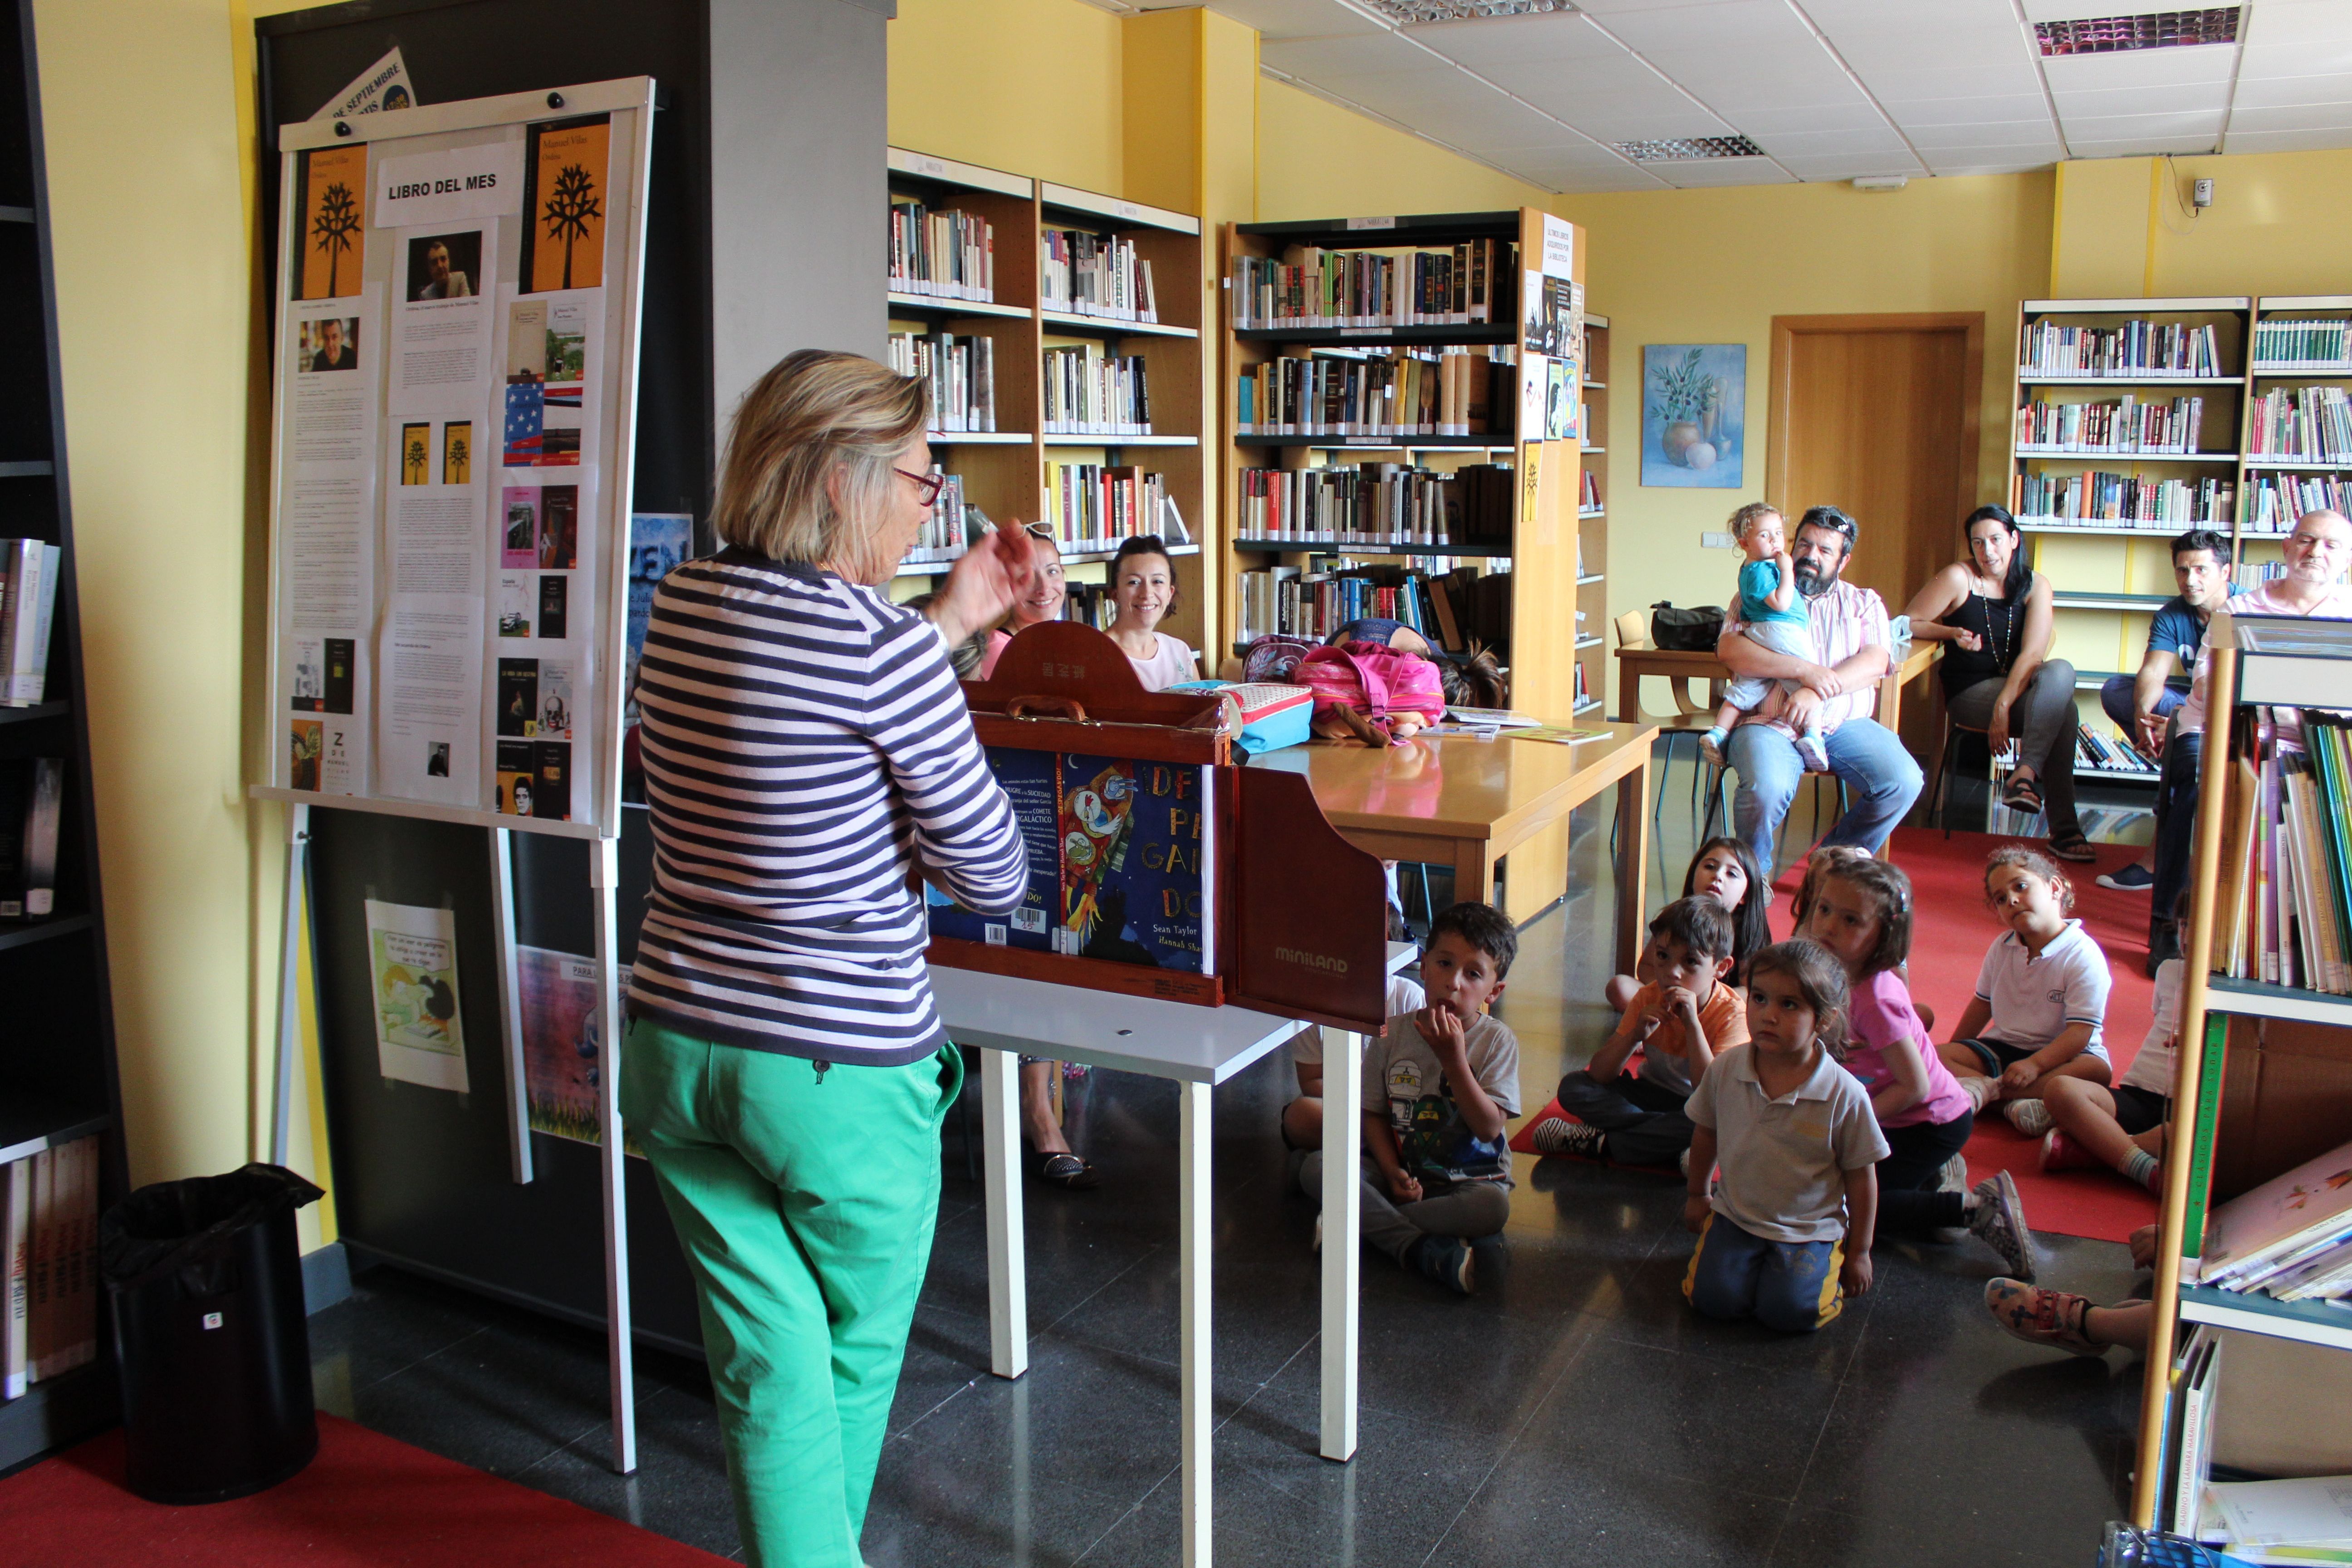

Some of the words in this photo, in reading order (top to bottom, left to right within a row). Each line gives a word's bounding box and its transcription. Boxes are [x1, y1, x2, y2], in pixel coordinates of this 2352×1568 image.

[346, 63, 400, 112] SEPTIEMBRE
[544, 137, 569, 149] Manuel
[571, 135, 588, 144] Vilas
[313, 158, 333, 167] Manuel
[388, 186, 429, 200] LIBRO
[435, 180, 460, 195] DEL
[466, 173, 496, 190] MES
[1559, 232, 1569, 240] LIBROS
[1547, 240, 1563, 250] ADQUIRIDOS
[1552, 253, 1568, 262] BIBLIOTECA
[334, 733, 343, 746] Z
[1143, 766, 1202, 801] ¡DE
[1028, 790, 1051, 798] SUCIEDAD
[1016, 814, 1052, 823] RGALÁCTICO
[1033, 868, 1056, 877] inesperado?
[1022, 921, 1035, 930] 15
[1153, 924, 1171, 933] Sean
[1173, 926, 1197, 936] Taylor
[1159, 936, 1185, 949] Hannah
[573, 966, 591, 976] PARA
[2195, 1128, 2210, 1187] CLÁSICOS
[2203, 1090, 2214, 1118] PARA
[2329, 1214, 2345, 1222] MICK
[2307, 1220, 2329, 1232] INKPEN
[2187, 1404, 2197, 1448] MARAVILLOSA
[2182, 1450, 2193, 1479] LÁMPARA
